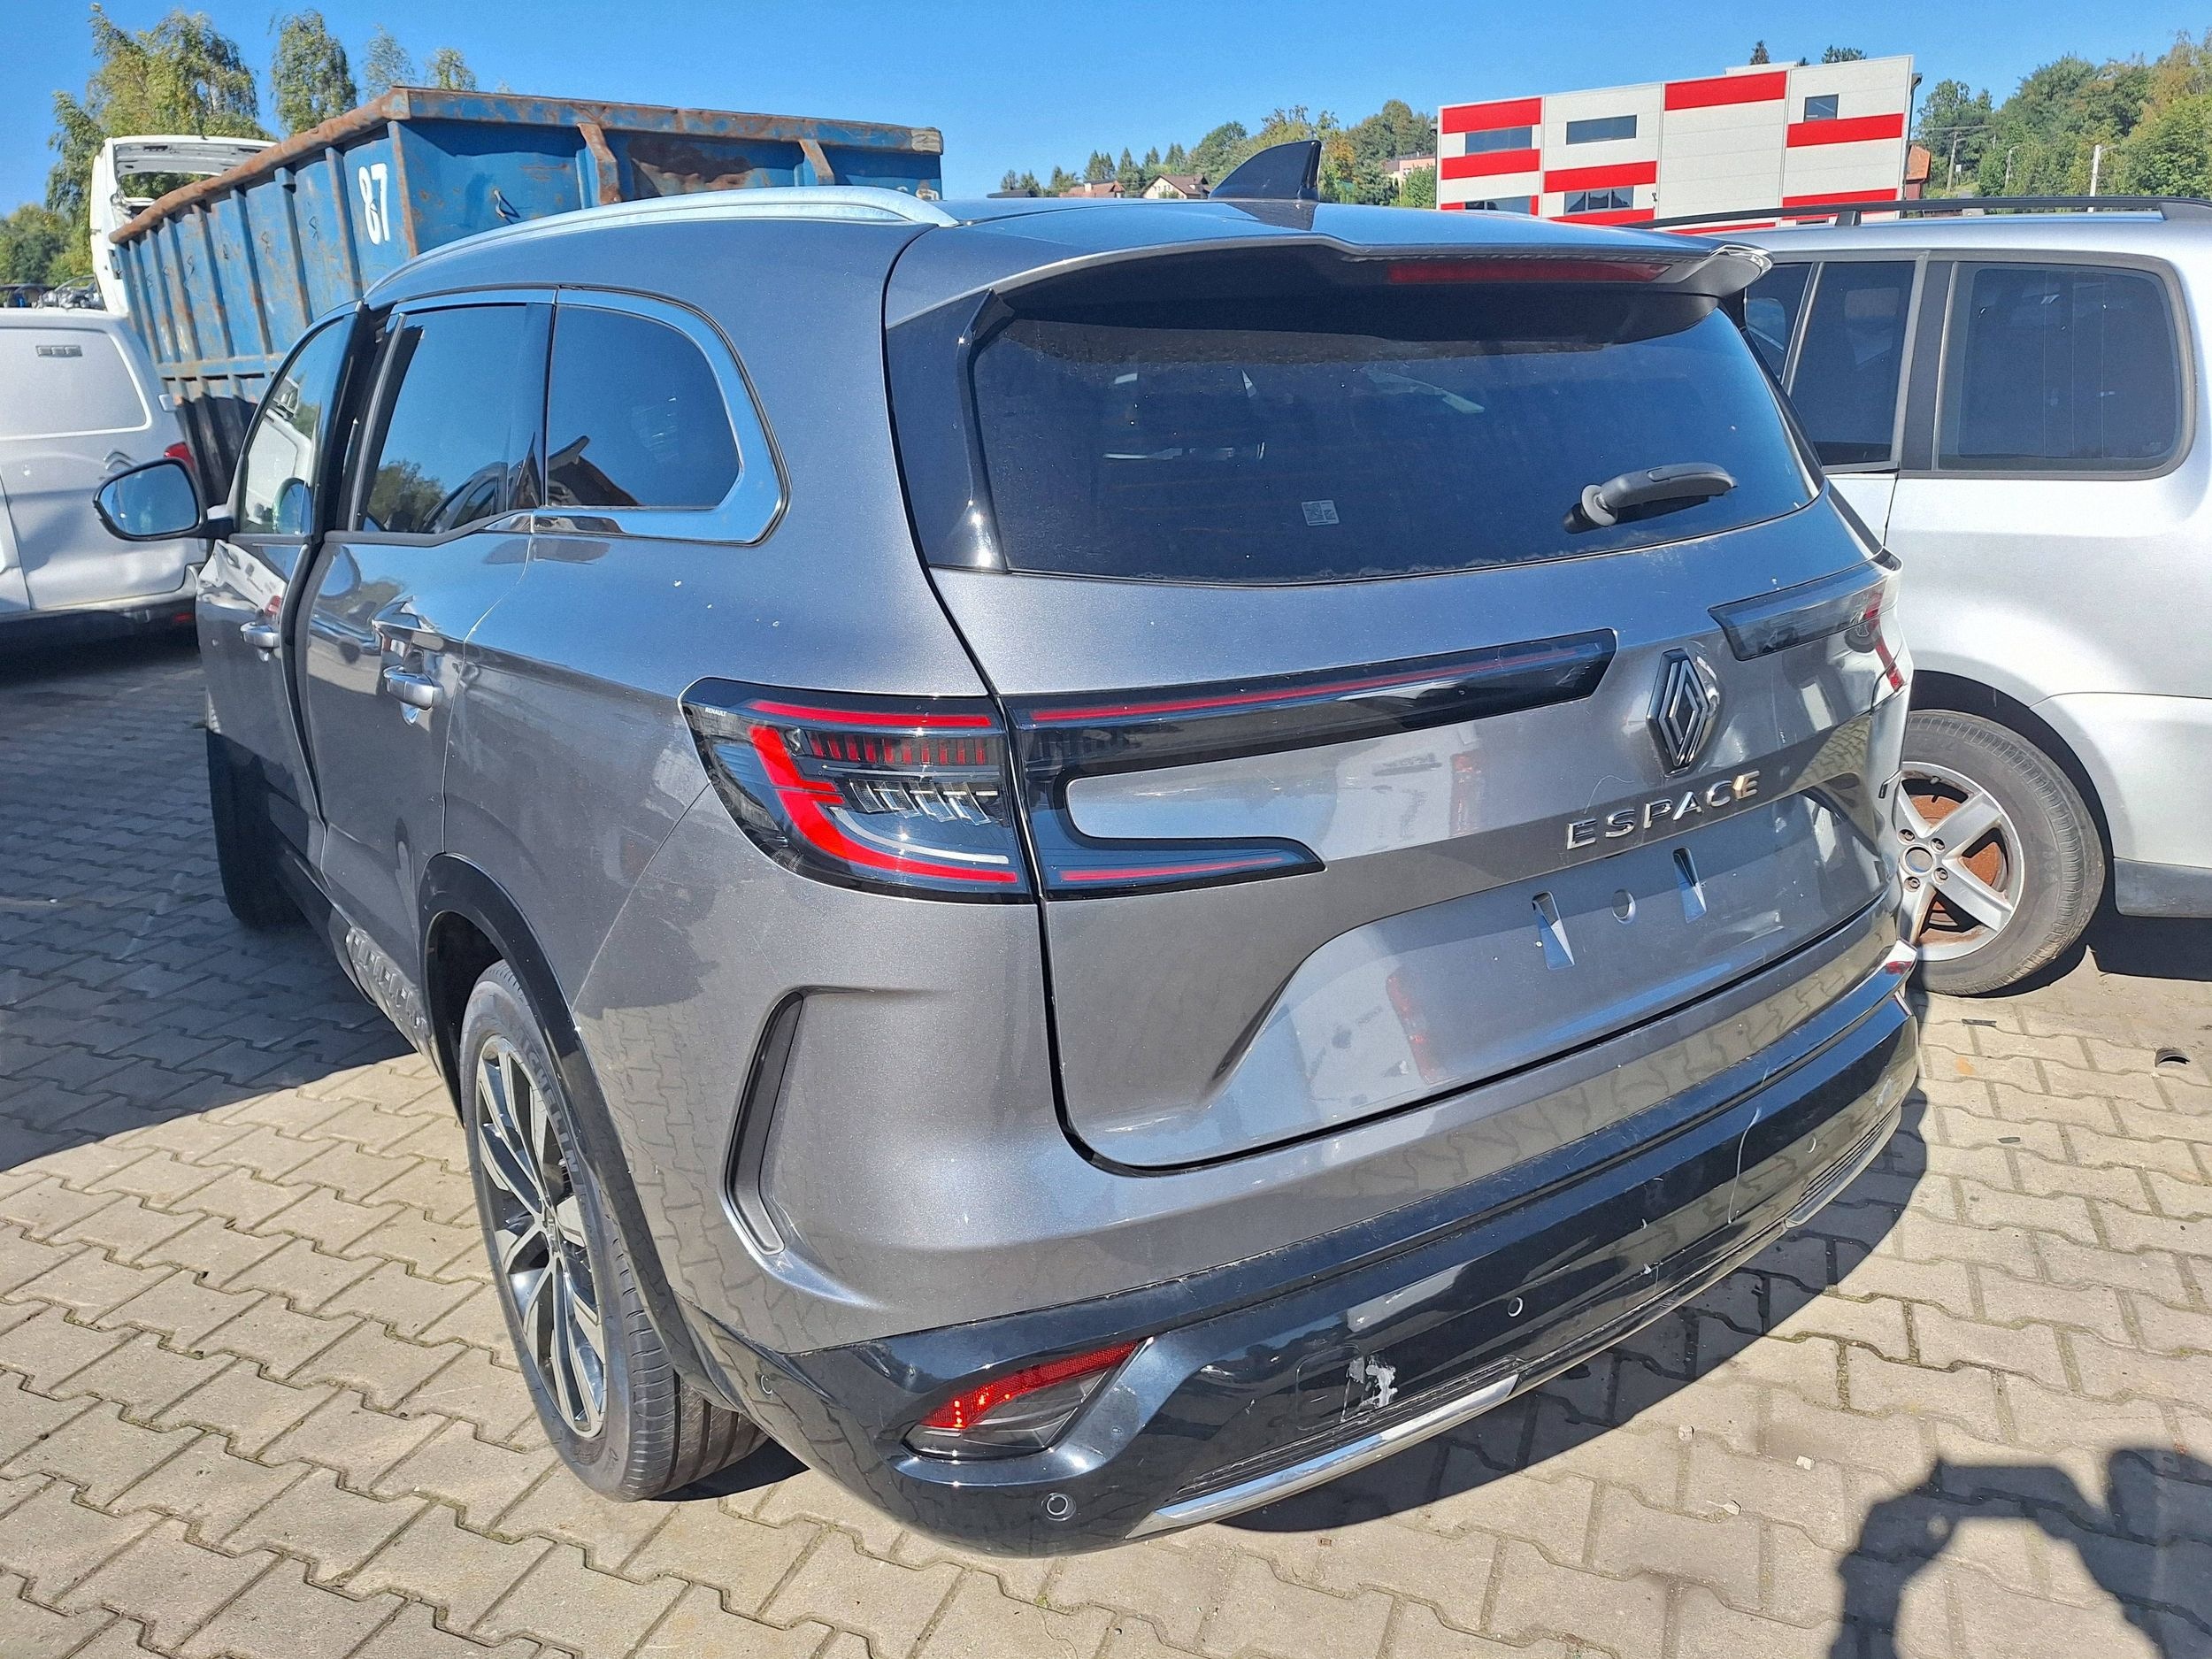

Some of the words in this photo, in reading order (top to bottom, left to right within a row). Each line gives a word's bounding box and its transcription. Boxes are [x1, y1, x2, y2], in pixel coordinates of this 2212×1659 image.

[358, 163, 390, 245] 87
[704, 707, 727, 717] RENAULT
[1566, 770, 1761, 850] ESPACE
